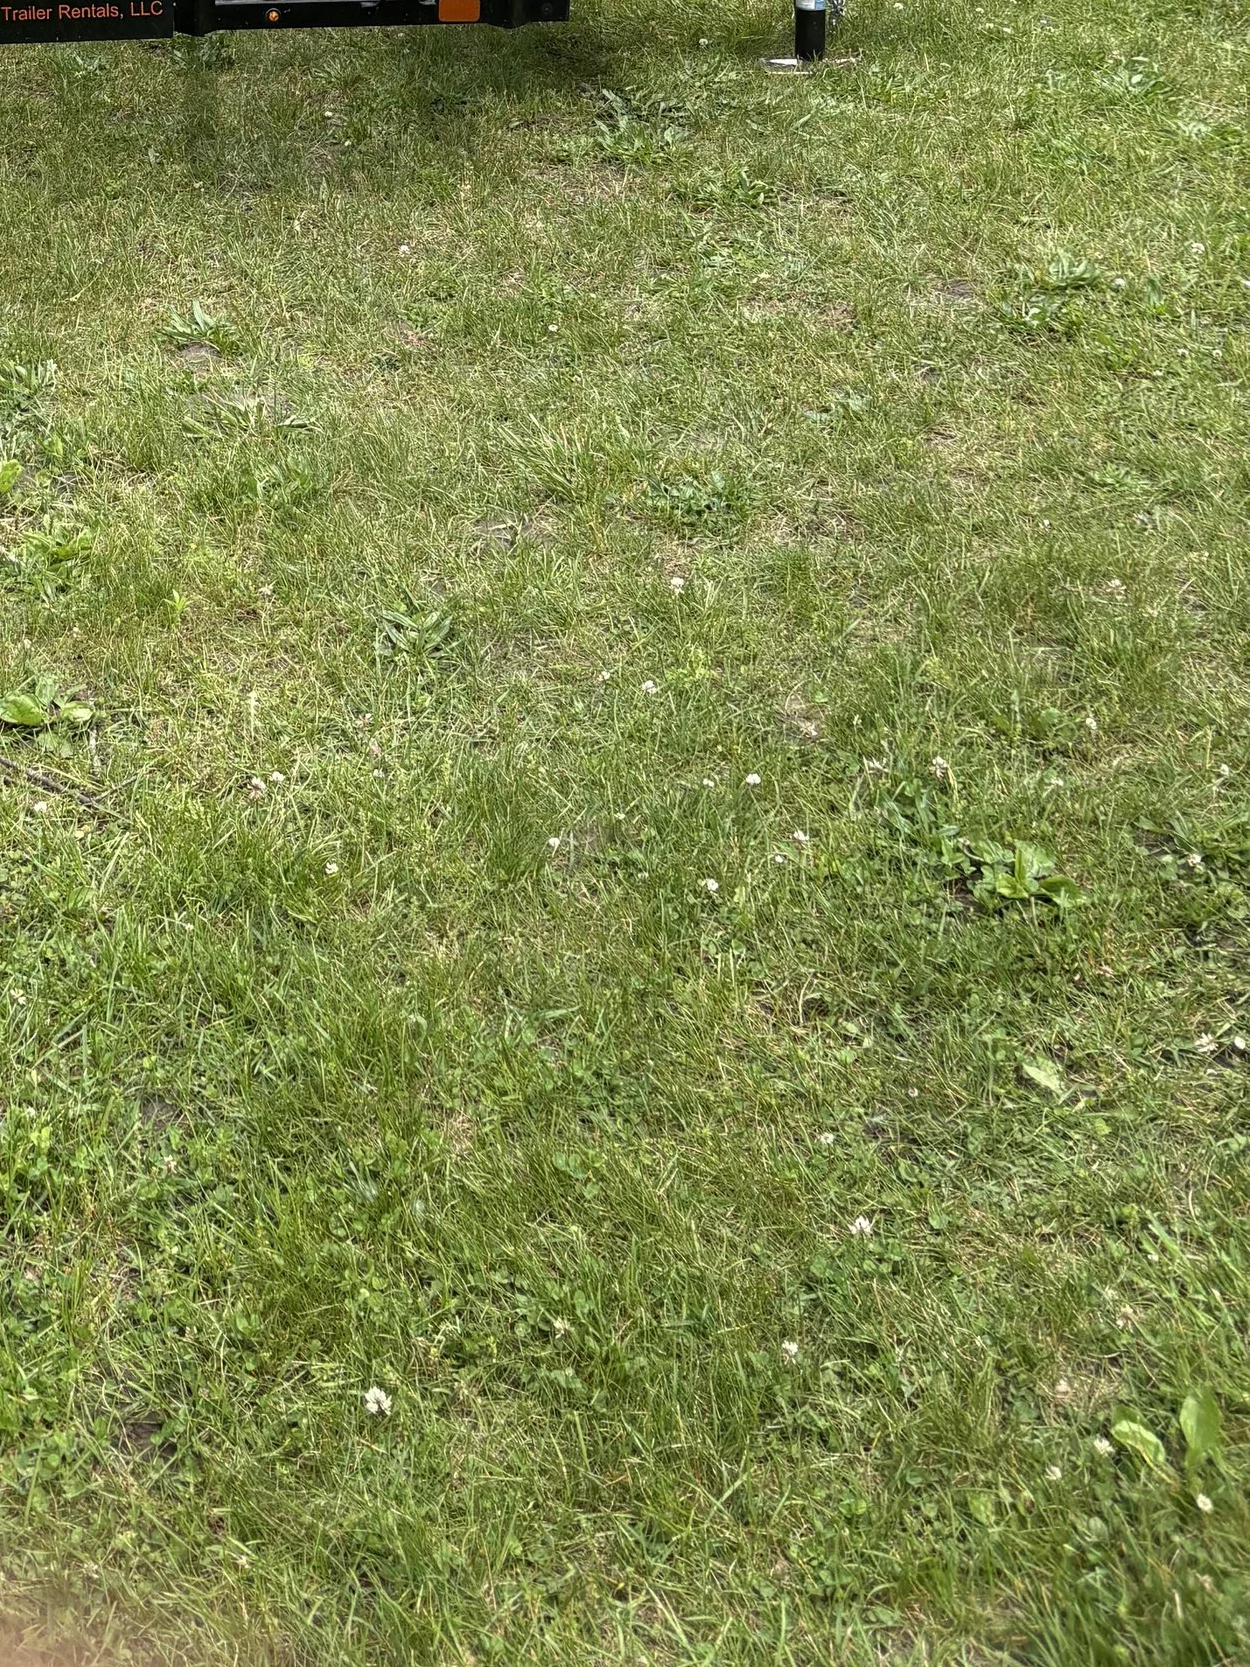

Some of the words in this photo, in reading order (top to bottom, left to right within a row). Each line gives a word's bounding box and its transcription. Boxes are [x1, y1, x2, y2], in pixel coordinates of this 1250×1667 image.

[1, 6, 52, 22] Trailer
[58, 3, 124, 20] Rentals,
[130, 0, 163, 17] LLC
